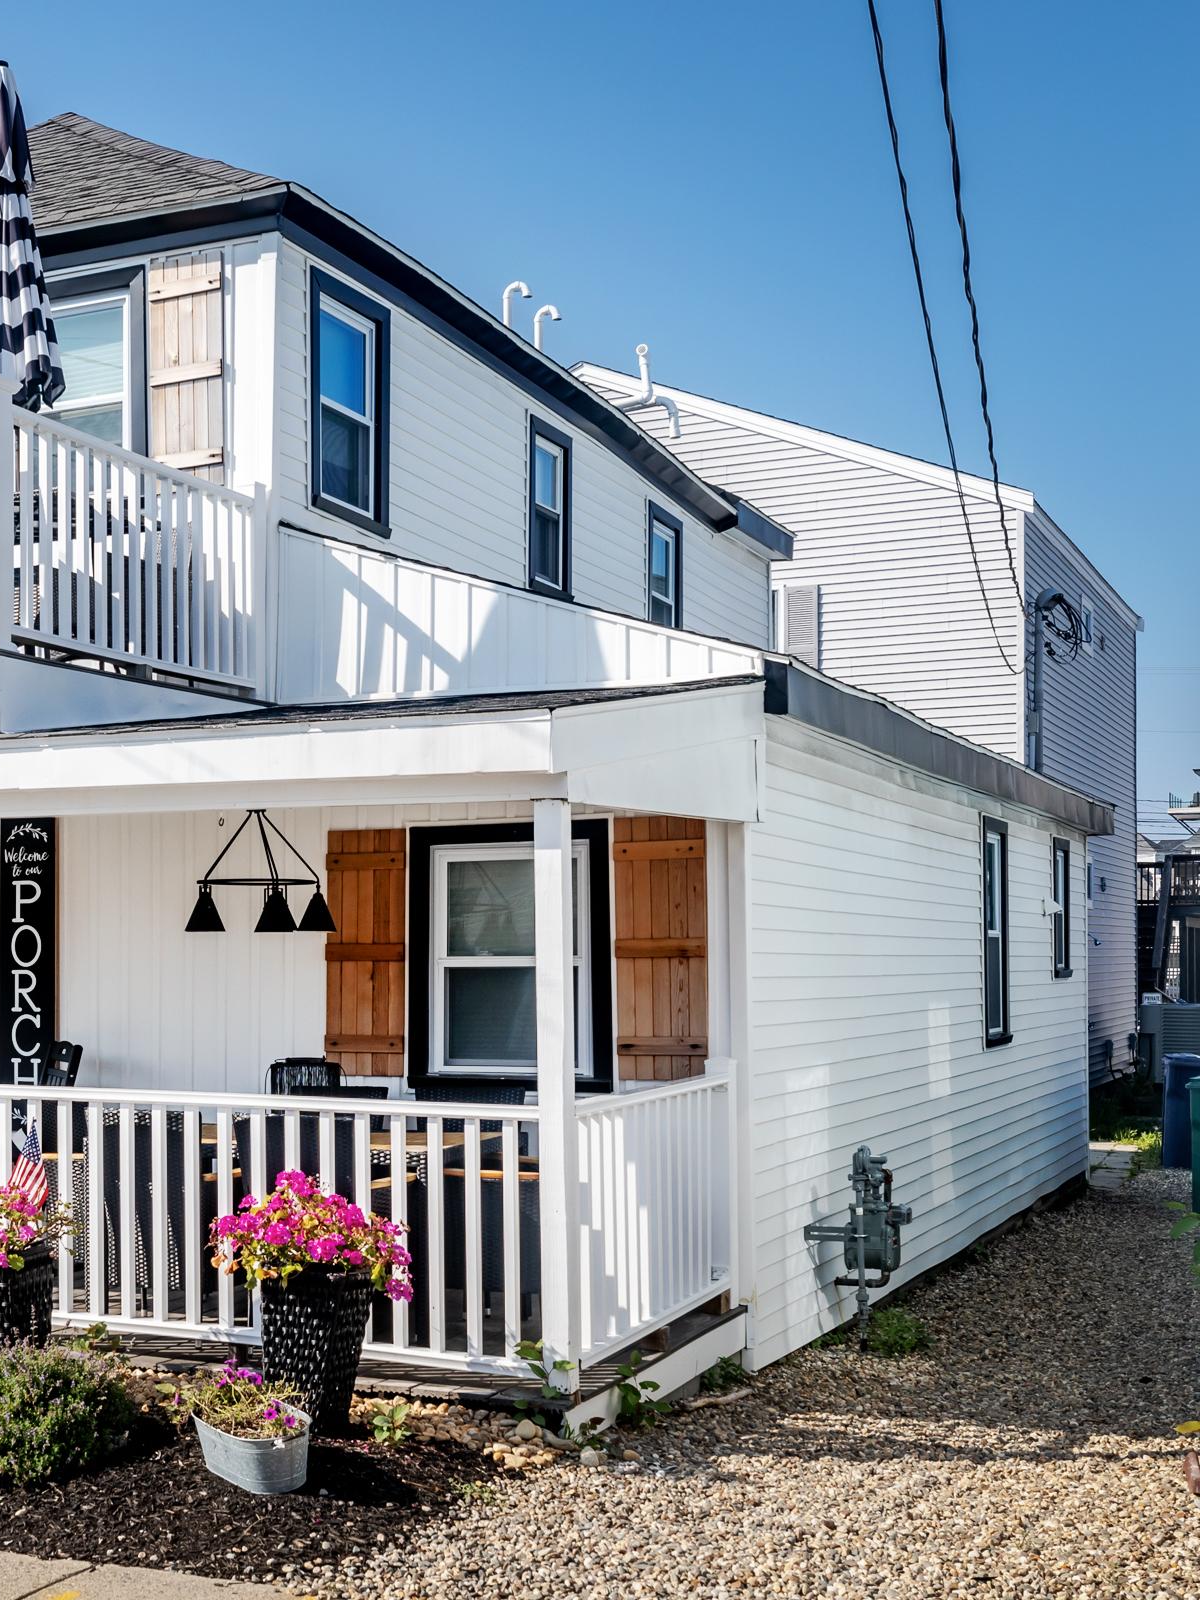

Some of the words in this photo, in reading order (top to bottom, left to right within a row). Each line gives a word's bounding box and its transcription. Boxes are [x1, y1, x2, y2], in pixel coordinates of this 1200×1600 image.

[4, 846, 49, 863] Welcome
[12, 864, 22, 877] to
[25, 865, 42, 875] our
[11, 880, 42, 1085] PORCH
